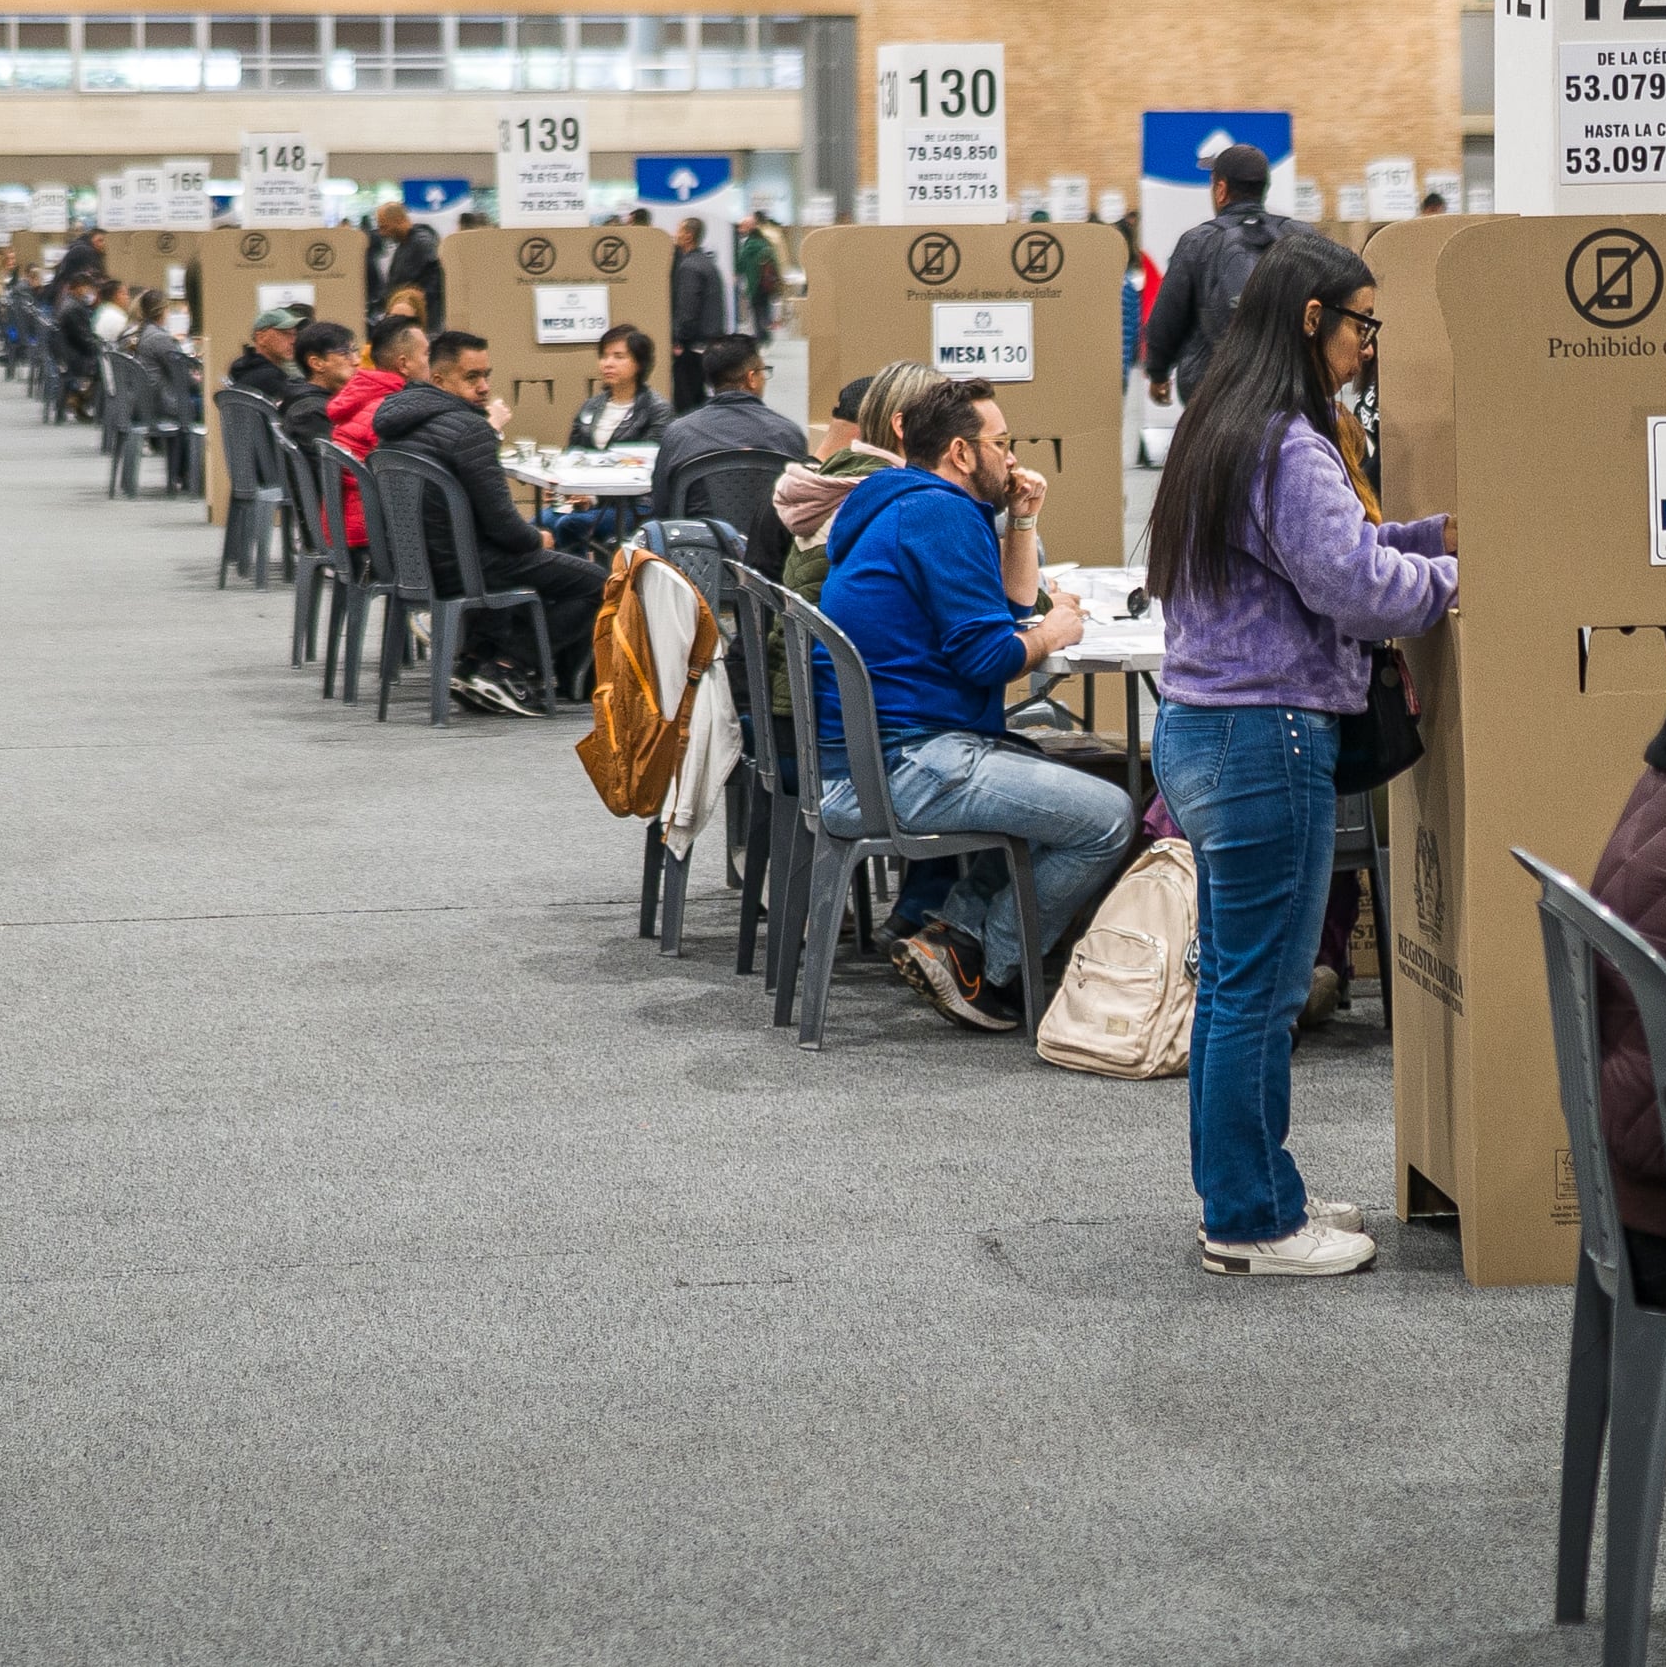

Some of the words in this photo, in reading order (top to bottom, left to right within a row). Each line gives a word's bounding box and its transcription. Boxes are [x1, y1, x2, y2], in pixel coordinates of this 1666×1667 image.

[1597, 51, 1617, 67] DE
[1620, 51, 1638, 66] LA
[878, 70, 898, 120] 130
[909, 67, 997, 118] 130
[516, 117, 580, 153] 139
[1584, 123, 1630, 139] HASTA
[1634, 122, 1653, 138] LA
[256, 145, 306, 172] 148
[908, 185, 999, 201] 79.551.713
[940, 347, 987, 364] MESA
[991, 345, 1027, 364] 130
[1548, 336, 1656, 359] Prohibido
[1397, 933, 1464, 1000] REGISTRADURÍA
